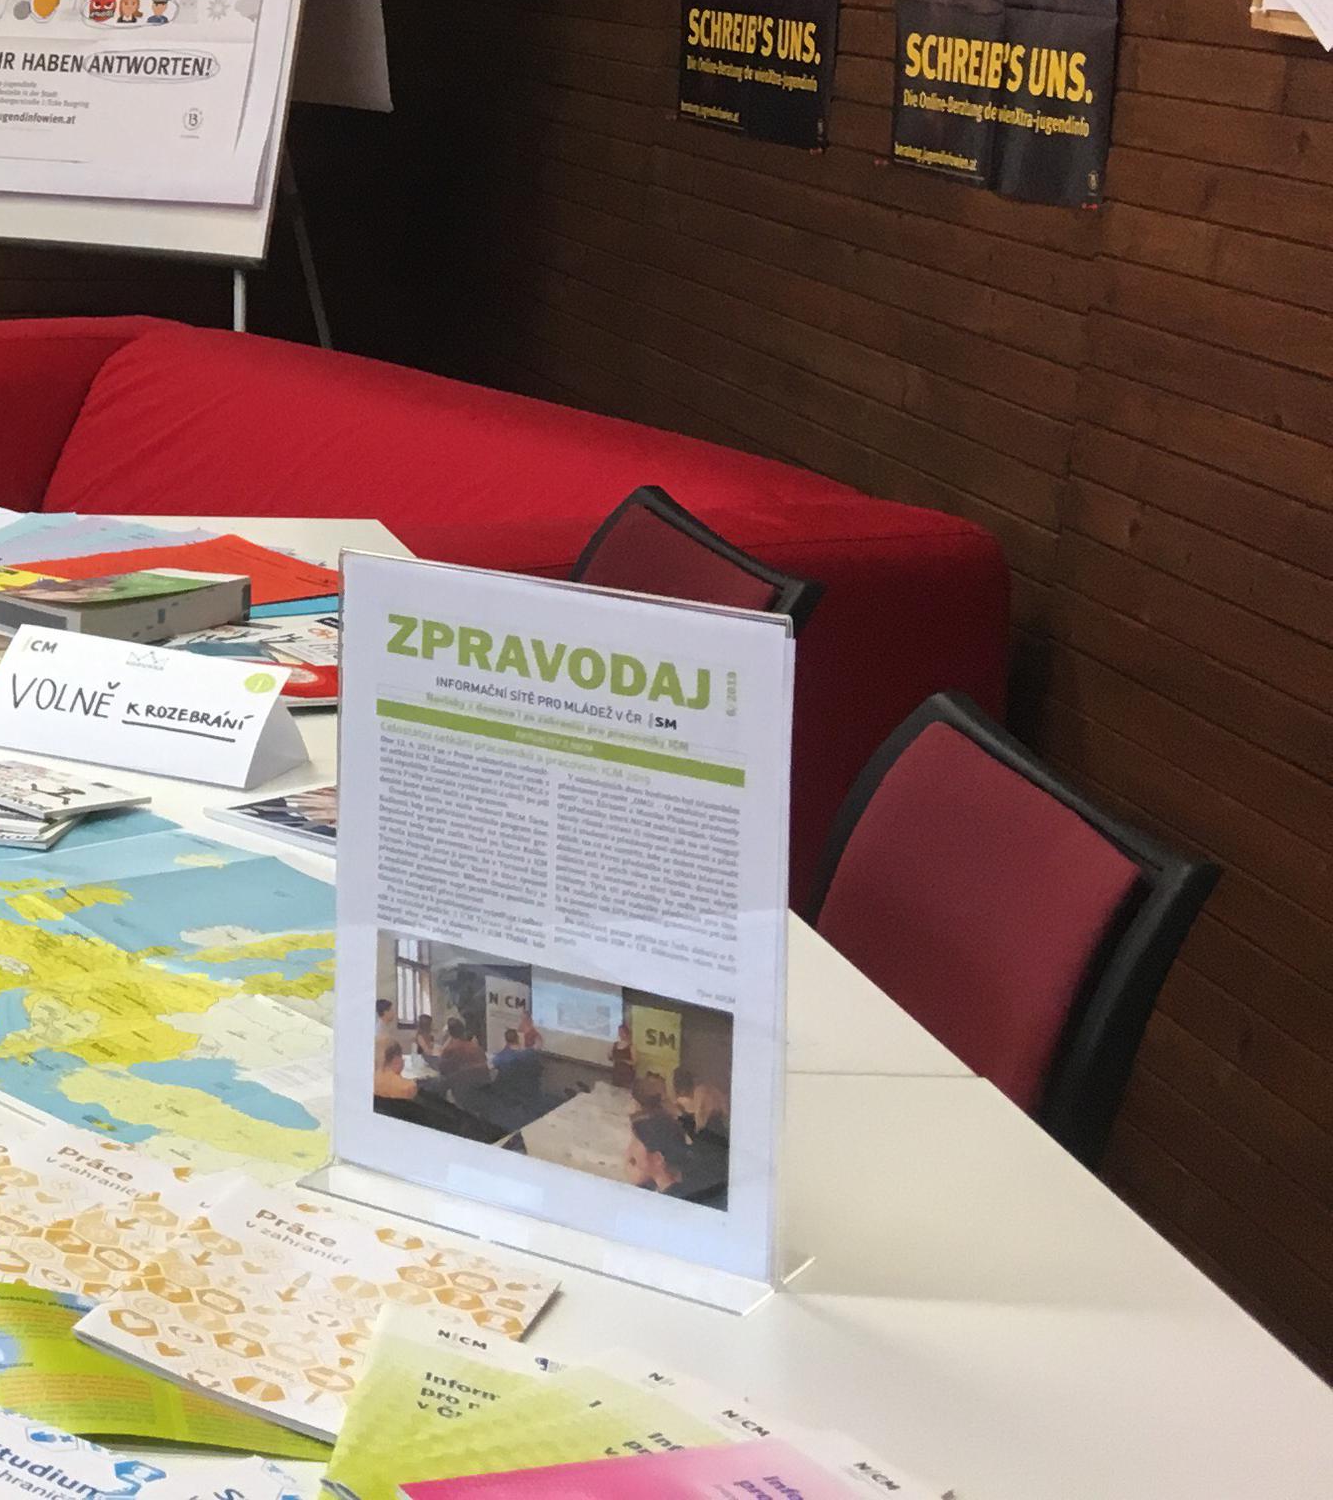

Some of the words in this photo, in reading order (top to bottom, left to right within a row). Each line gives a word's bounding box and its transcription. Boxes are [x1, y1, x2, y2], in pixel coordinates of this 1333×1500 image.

[21, 52, 85, 73] HABEN
[86, 55, 214, 77] ANTWORTEN!
[776, 18, 821, 66] UNS.
[1027, 47, 1094, 105] UNS.
[386, 612, 712, 711] ZPRAVODAJ
[12, 673, 121, 718] VOLNĚ
[126, 702, 141, 717] K
[144, 704, 255, 730] ROZEBRÁNÍ
[435, 675, 508, 700] INFORMAČNÍ
[509, 688, 535, 705] SÍTĚ
[537, 694, 562, 710] PRO
[564, 700, 614, 721] MLÁDEŽ
[615, 711, 624, 722] V
[625, 709, 643, 725] ČR
[56, 1146, 134, 1182] Práce
[255, 1209, 337, 1247] Práce
[420, 1386, 461, 1406] pro
